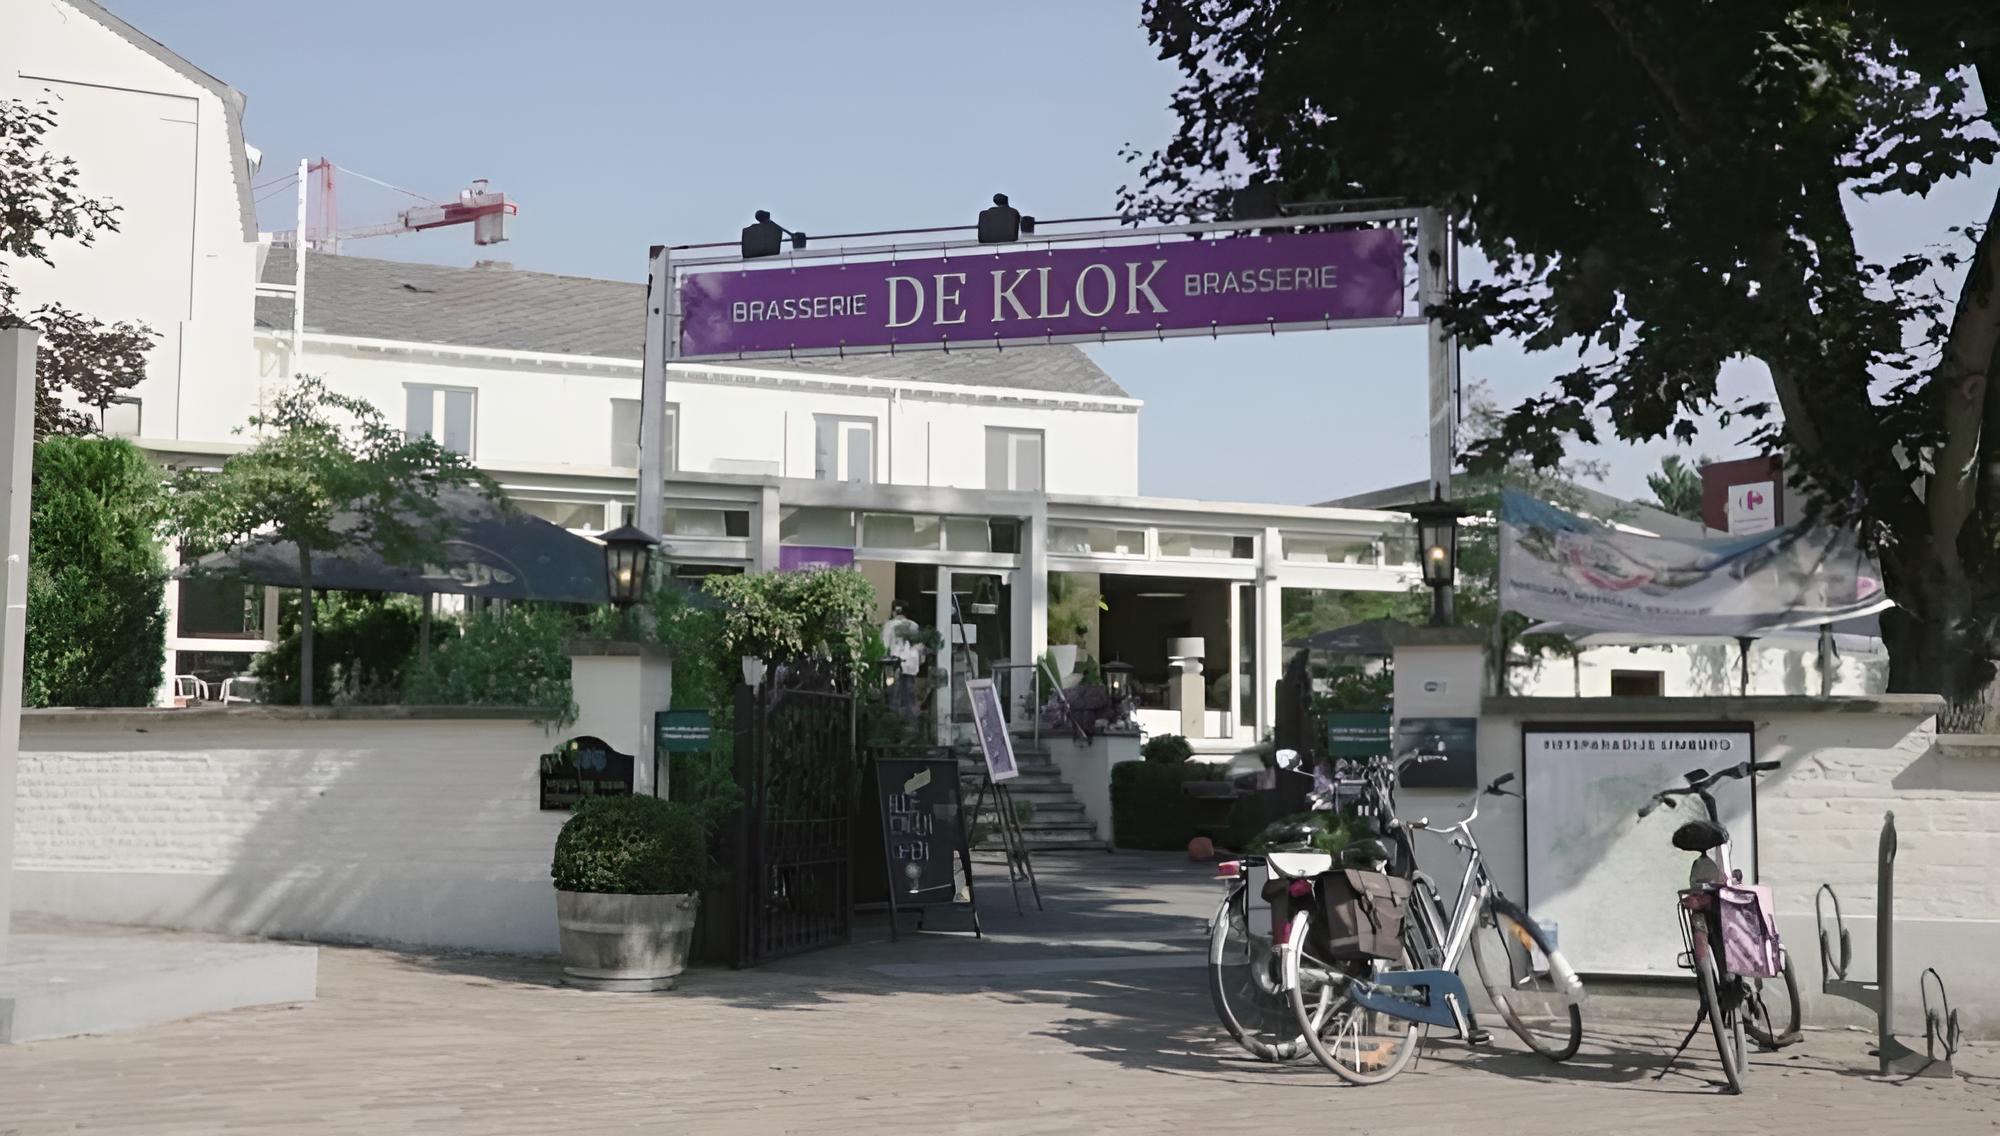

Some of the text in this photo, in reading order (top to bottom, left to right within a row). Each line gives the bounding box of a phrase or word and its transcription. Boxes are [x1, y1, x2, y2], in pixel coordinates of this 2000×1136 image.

[732, 258, 1338, 328] BRASSERIE DE KLOK BRASSERIE
